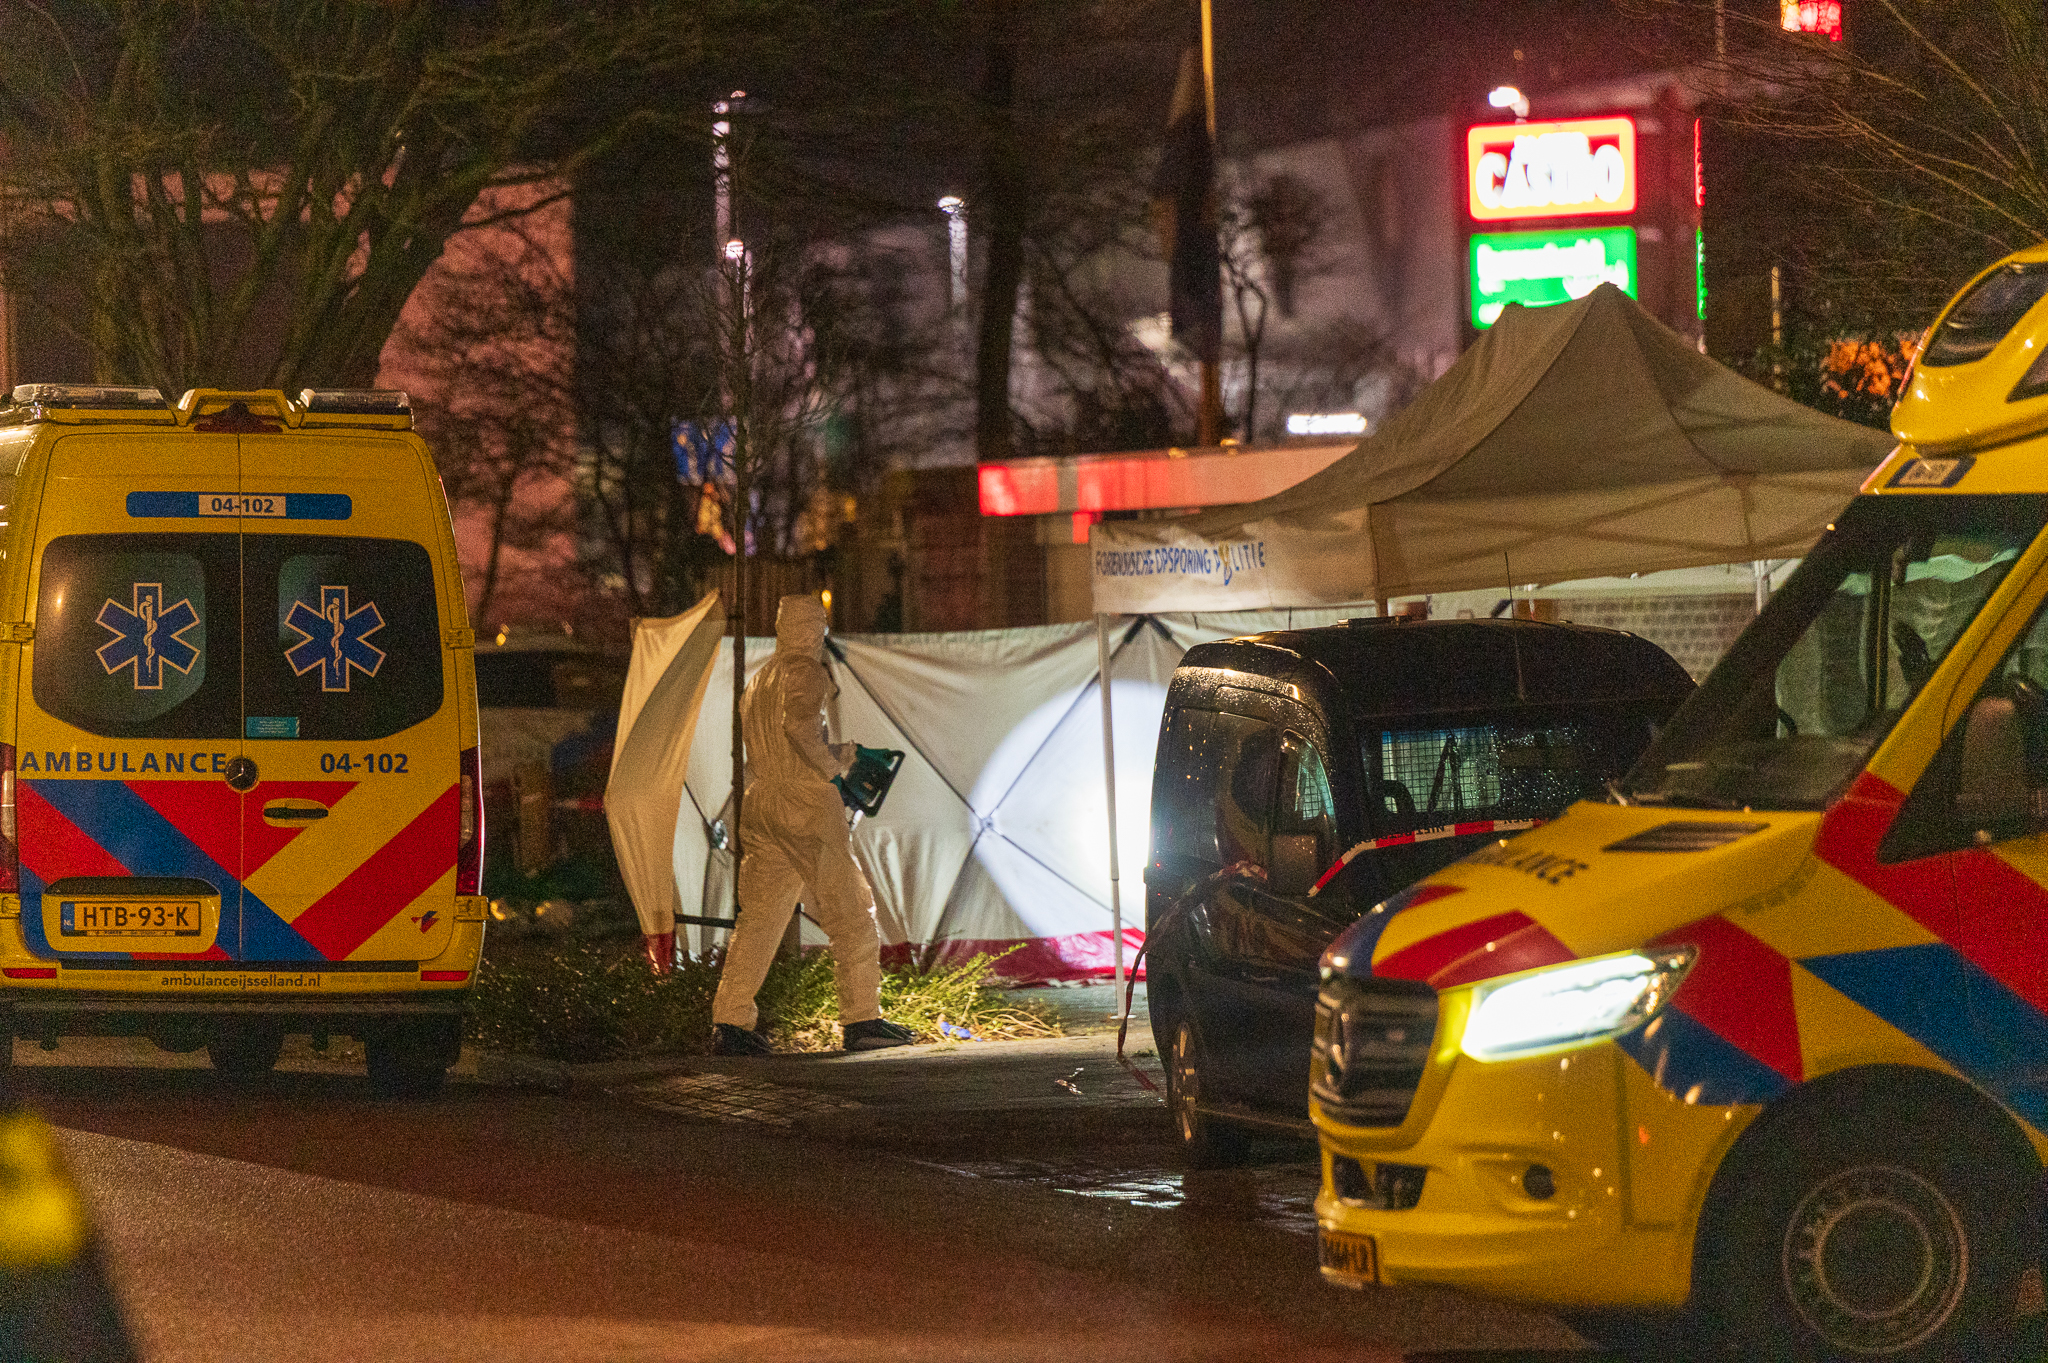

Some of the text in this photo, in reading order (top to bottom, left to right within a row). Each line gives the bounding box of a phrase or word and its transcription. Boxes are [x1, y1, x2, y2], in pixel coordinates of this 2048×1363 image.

[211, 497, 275, 514] 04-102
[1155, 547, 1211, 575] OPSPORING
[19, 752, 227, 773] AMBULANCE
[320, 753, 409, 773] 04-102
[83, 906, 190, 927] HTB-93-K
[161, 973, 321, 990] ambulanceijsselland.nl
